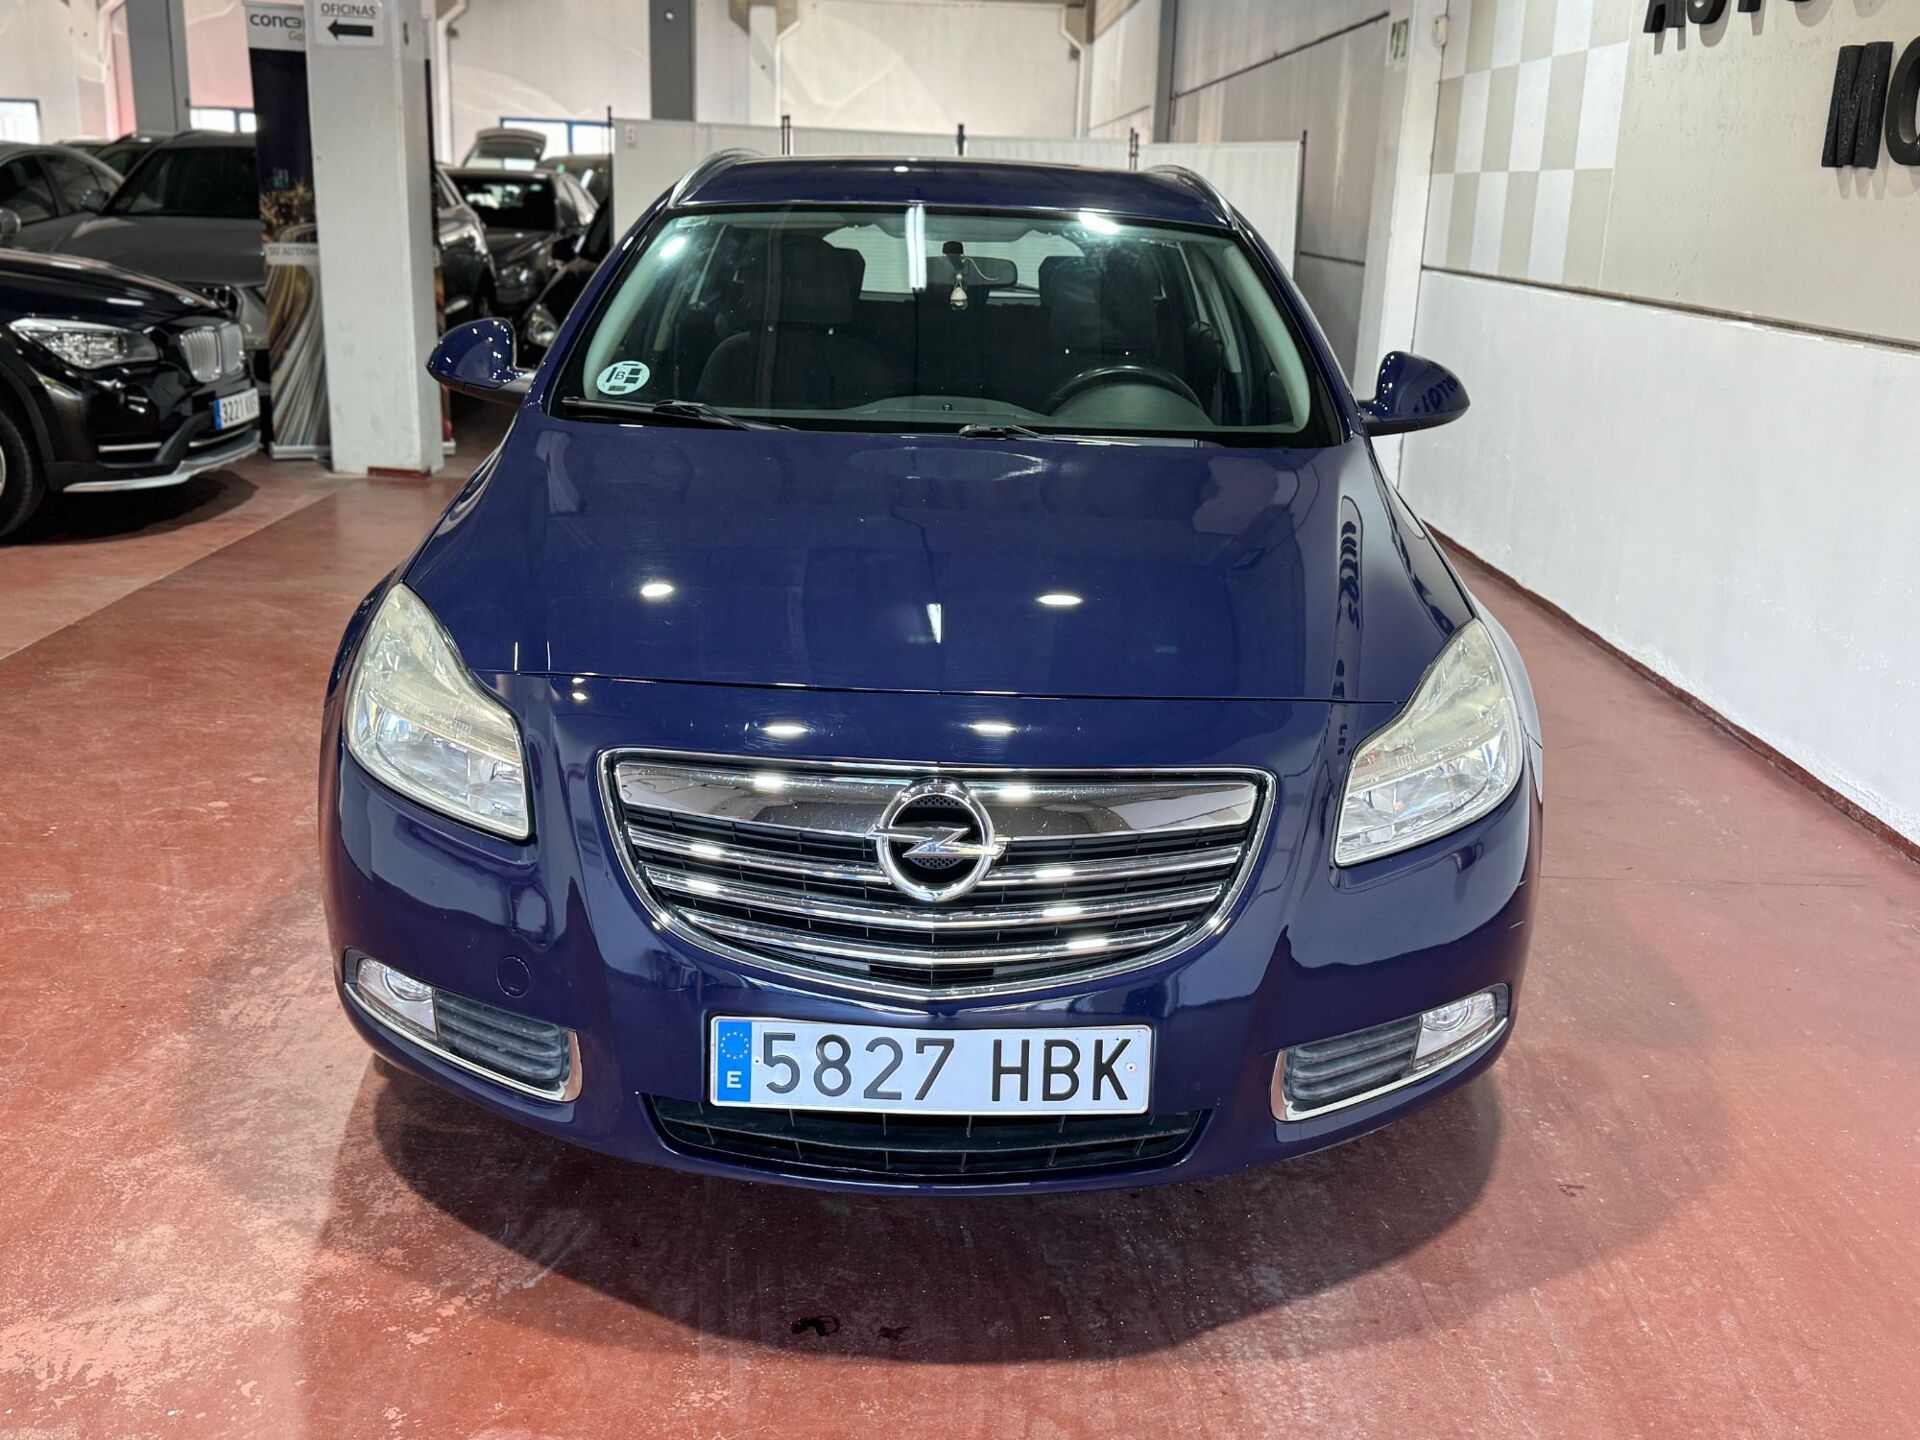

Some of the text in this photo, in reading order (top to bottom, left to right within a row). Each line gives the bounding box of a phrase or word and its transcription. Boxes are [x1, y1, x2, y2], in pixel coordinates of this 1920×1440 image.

[320, 3, 377, 17] OFICINAS
[281, 246, 318, 257] AUTOM
[614, 371, 626, 380] B
[763, 1032, 1132, 1102] 5827 HBK
[726, 1071, 742, 1088] E
